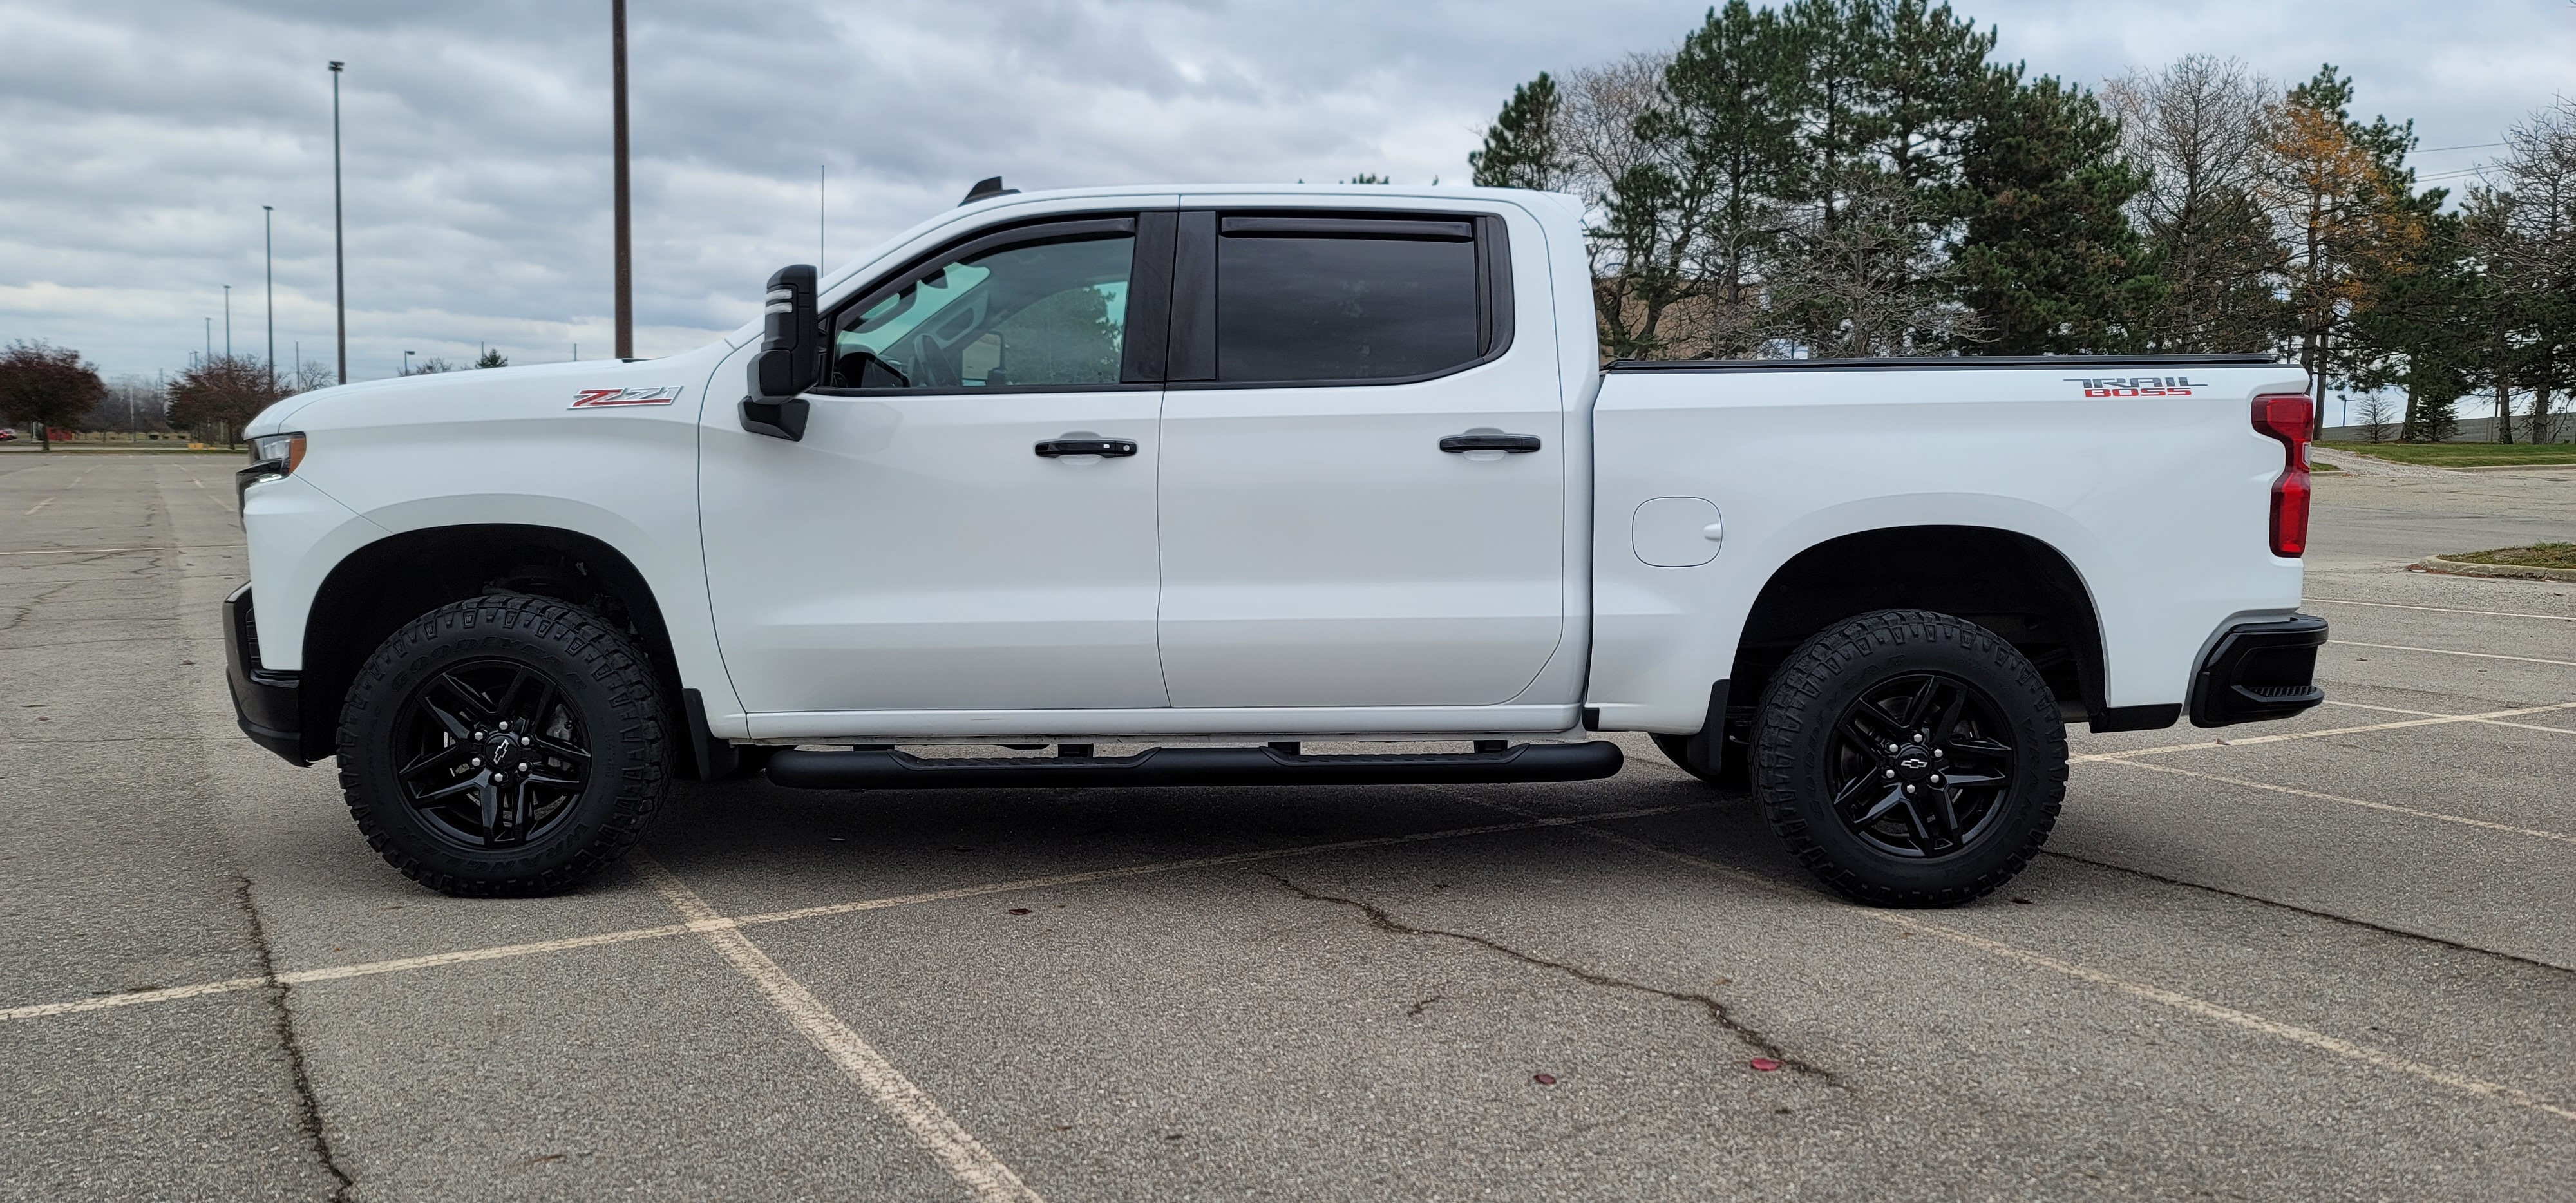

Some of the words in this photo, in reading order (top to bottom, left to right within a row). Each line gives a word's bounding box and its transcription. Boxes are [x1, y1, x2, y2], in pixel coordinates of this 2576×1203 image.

[2063, 377, 2208, 388] TRAIL
[2084, 388, 2192, 397] BOSS
[567, 386, 684, 410] Z71
[392, 636, 586, 692] GOODYEAR
[397, 823, 589, 872] WRANGLER
